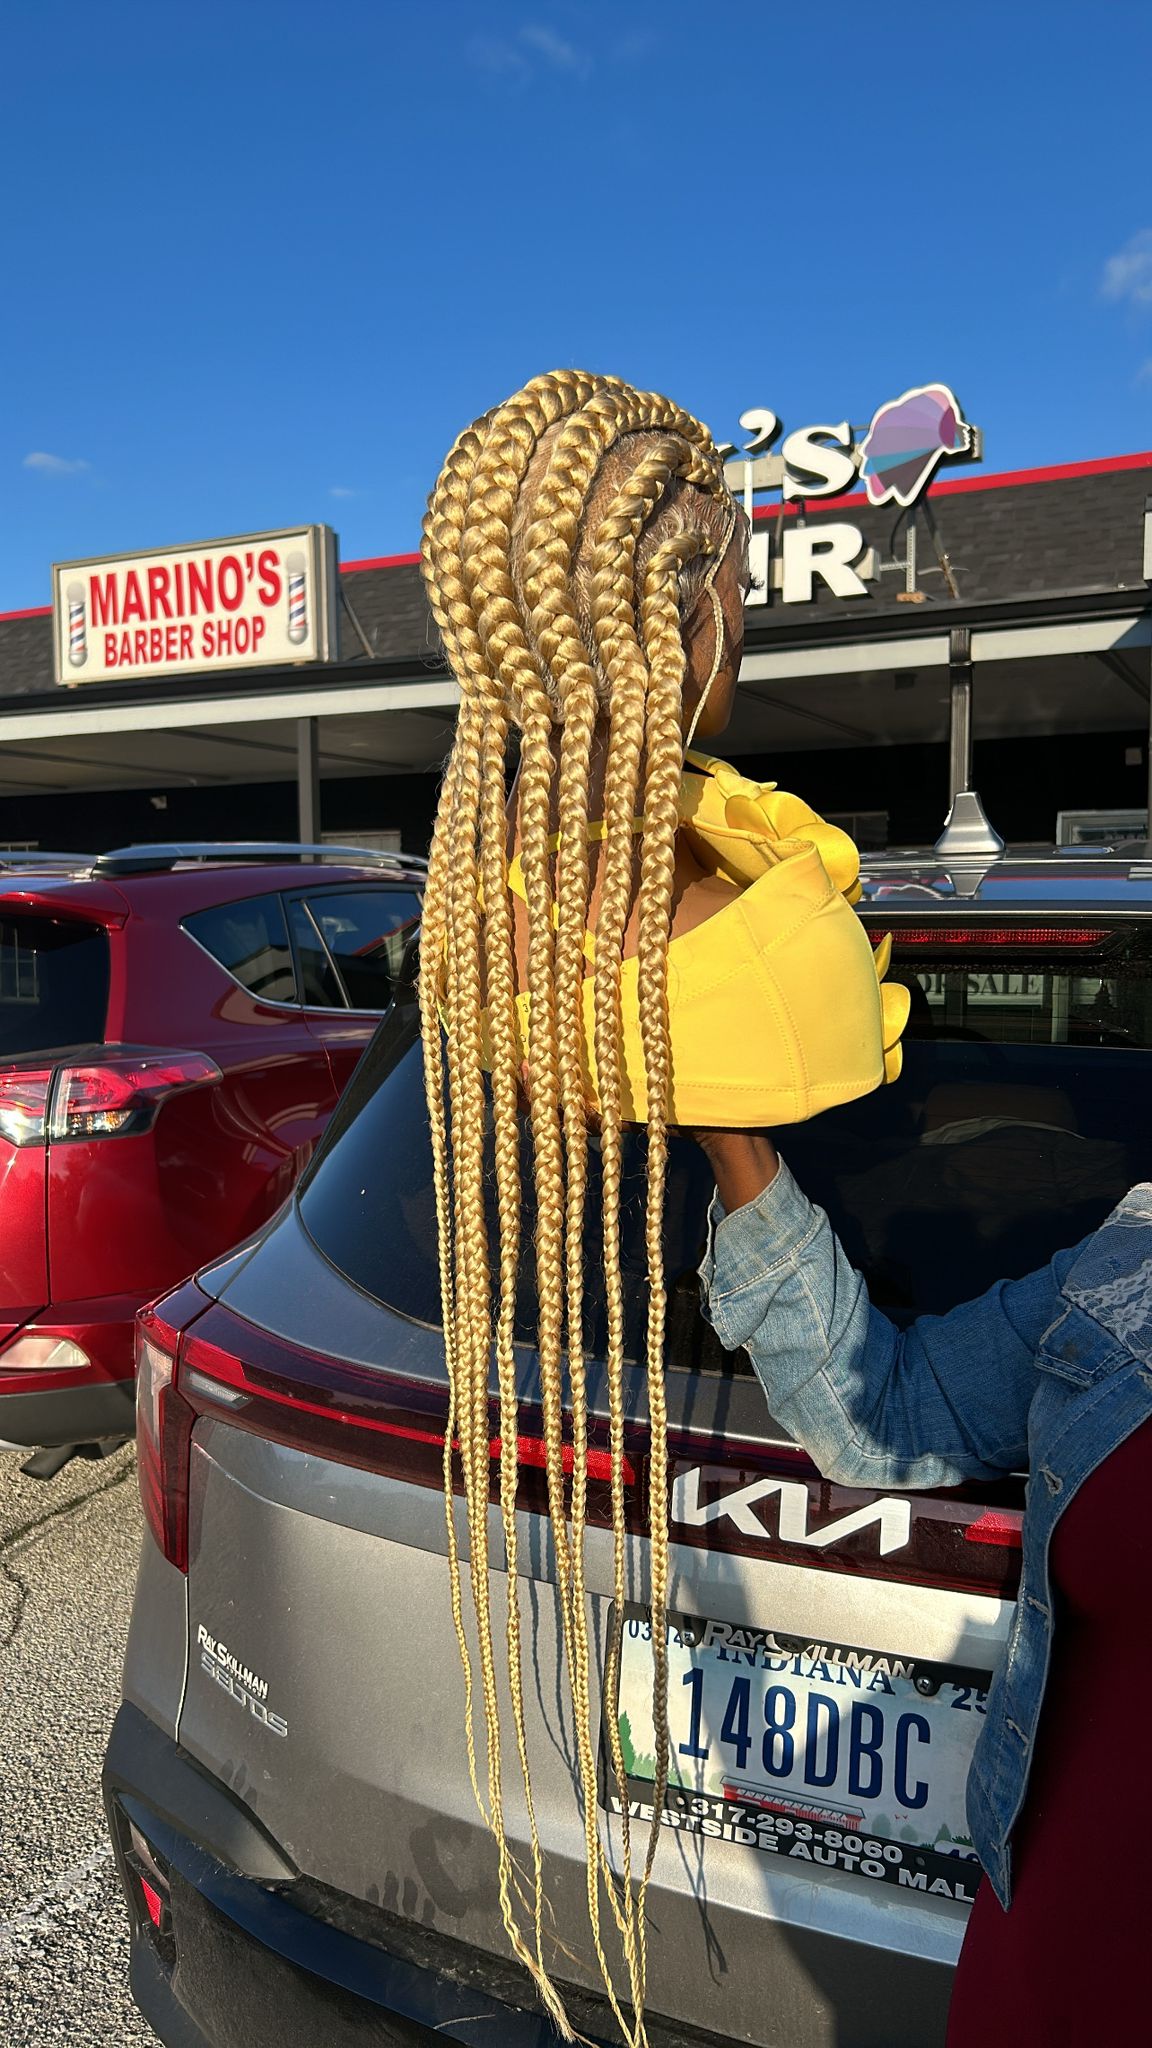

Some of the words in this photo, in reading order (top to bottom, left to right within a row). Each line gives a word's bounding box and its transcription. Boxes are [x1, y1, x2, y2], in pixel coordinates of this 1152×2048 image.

[716, 409, 855, 500] 'S
[89, 549, 283, 628] MARINO'S
[104, 624, 194, 668] BARBER
[202, 615, 265, 658] SHOP
[967, 973, 1041, 996] SALE
[672, 1467, 911, 1556] KIA
[197, 1624, 217, 1659] RAY
[217, 1642, 268, 1700] SKILLMAN
[703, 1620, 764, 1656] RAY
[201, 1652, 287, 1738] SELTOS
[678, 1666, 931, 1810] 148DBC
[611, 1797, 779, 1852] WESTSIDE
[788, 1841, 886, 1878] AUTO
[691, 1798, 904, 1865] 317-293-8060
